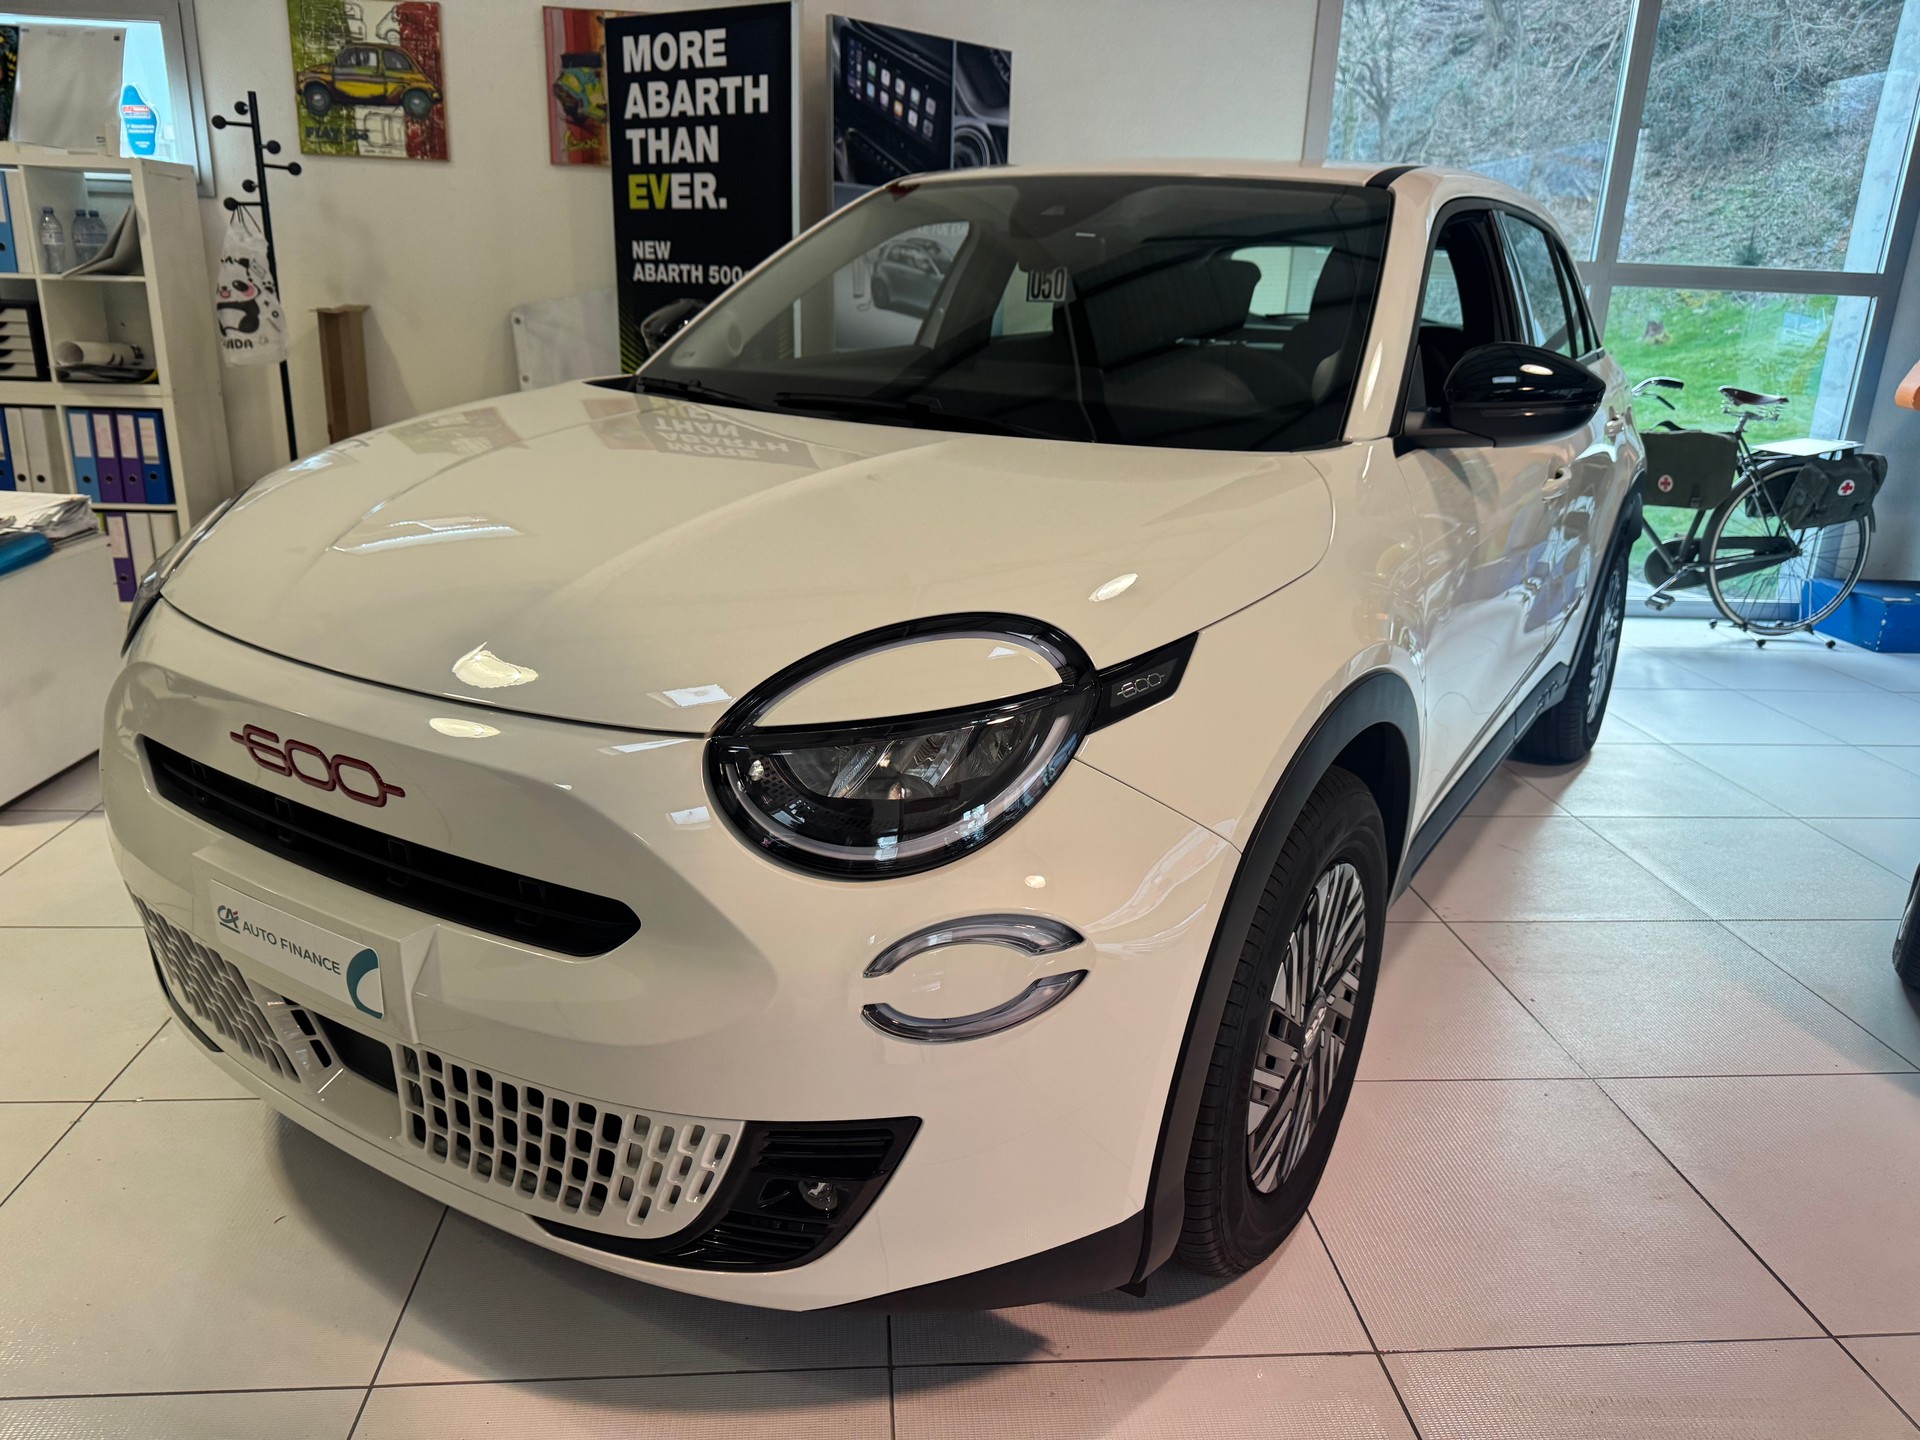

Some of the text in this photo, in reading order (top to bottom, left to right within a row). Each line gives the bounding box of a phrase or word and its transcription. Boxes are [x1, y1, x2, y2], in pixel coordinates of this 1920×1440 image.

[622, 28, 727, 73] MORE
[624, 74, 769, 119] ABARTH
[625, 125, 719, 165] THAN
[628, 172, 728, 210] EVER.
[631, 240, 671, 260] NEW
[633, 262, 703, 284] ABARTH
[1117, 672, 1166, 698] 600
[229, 723, 406, 808] 600
[243, 921, 277, 945] AUTO
[280, 937, 342, 976] FINANCE
